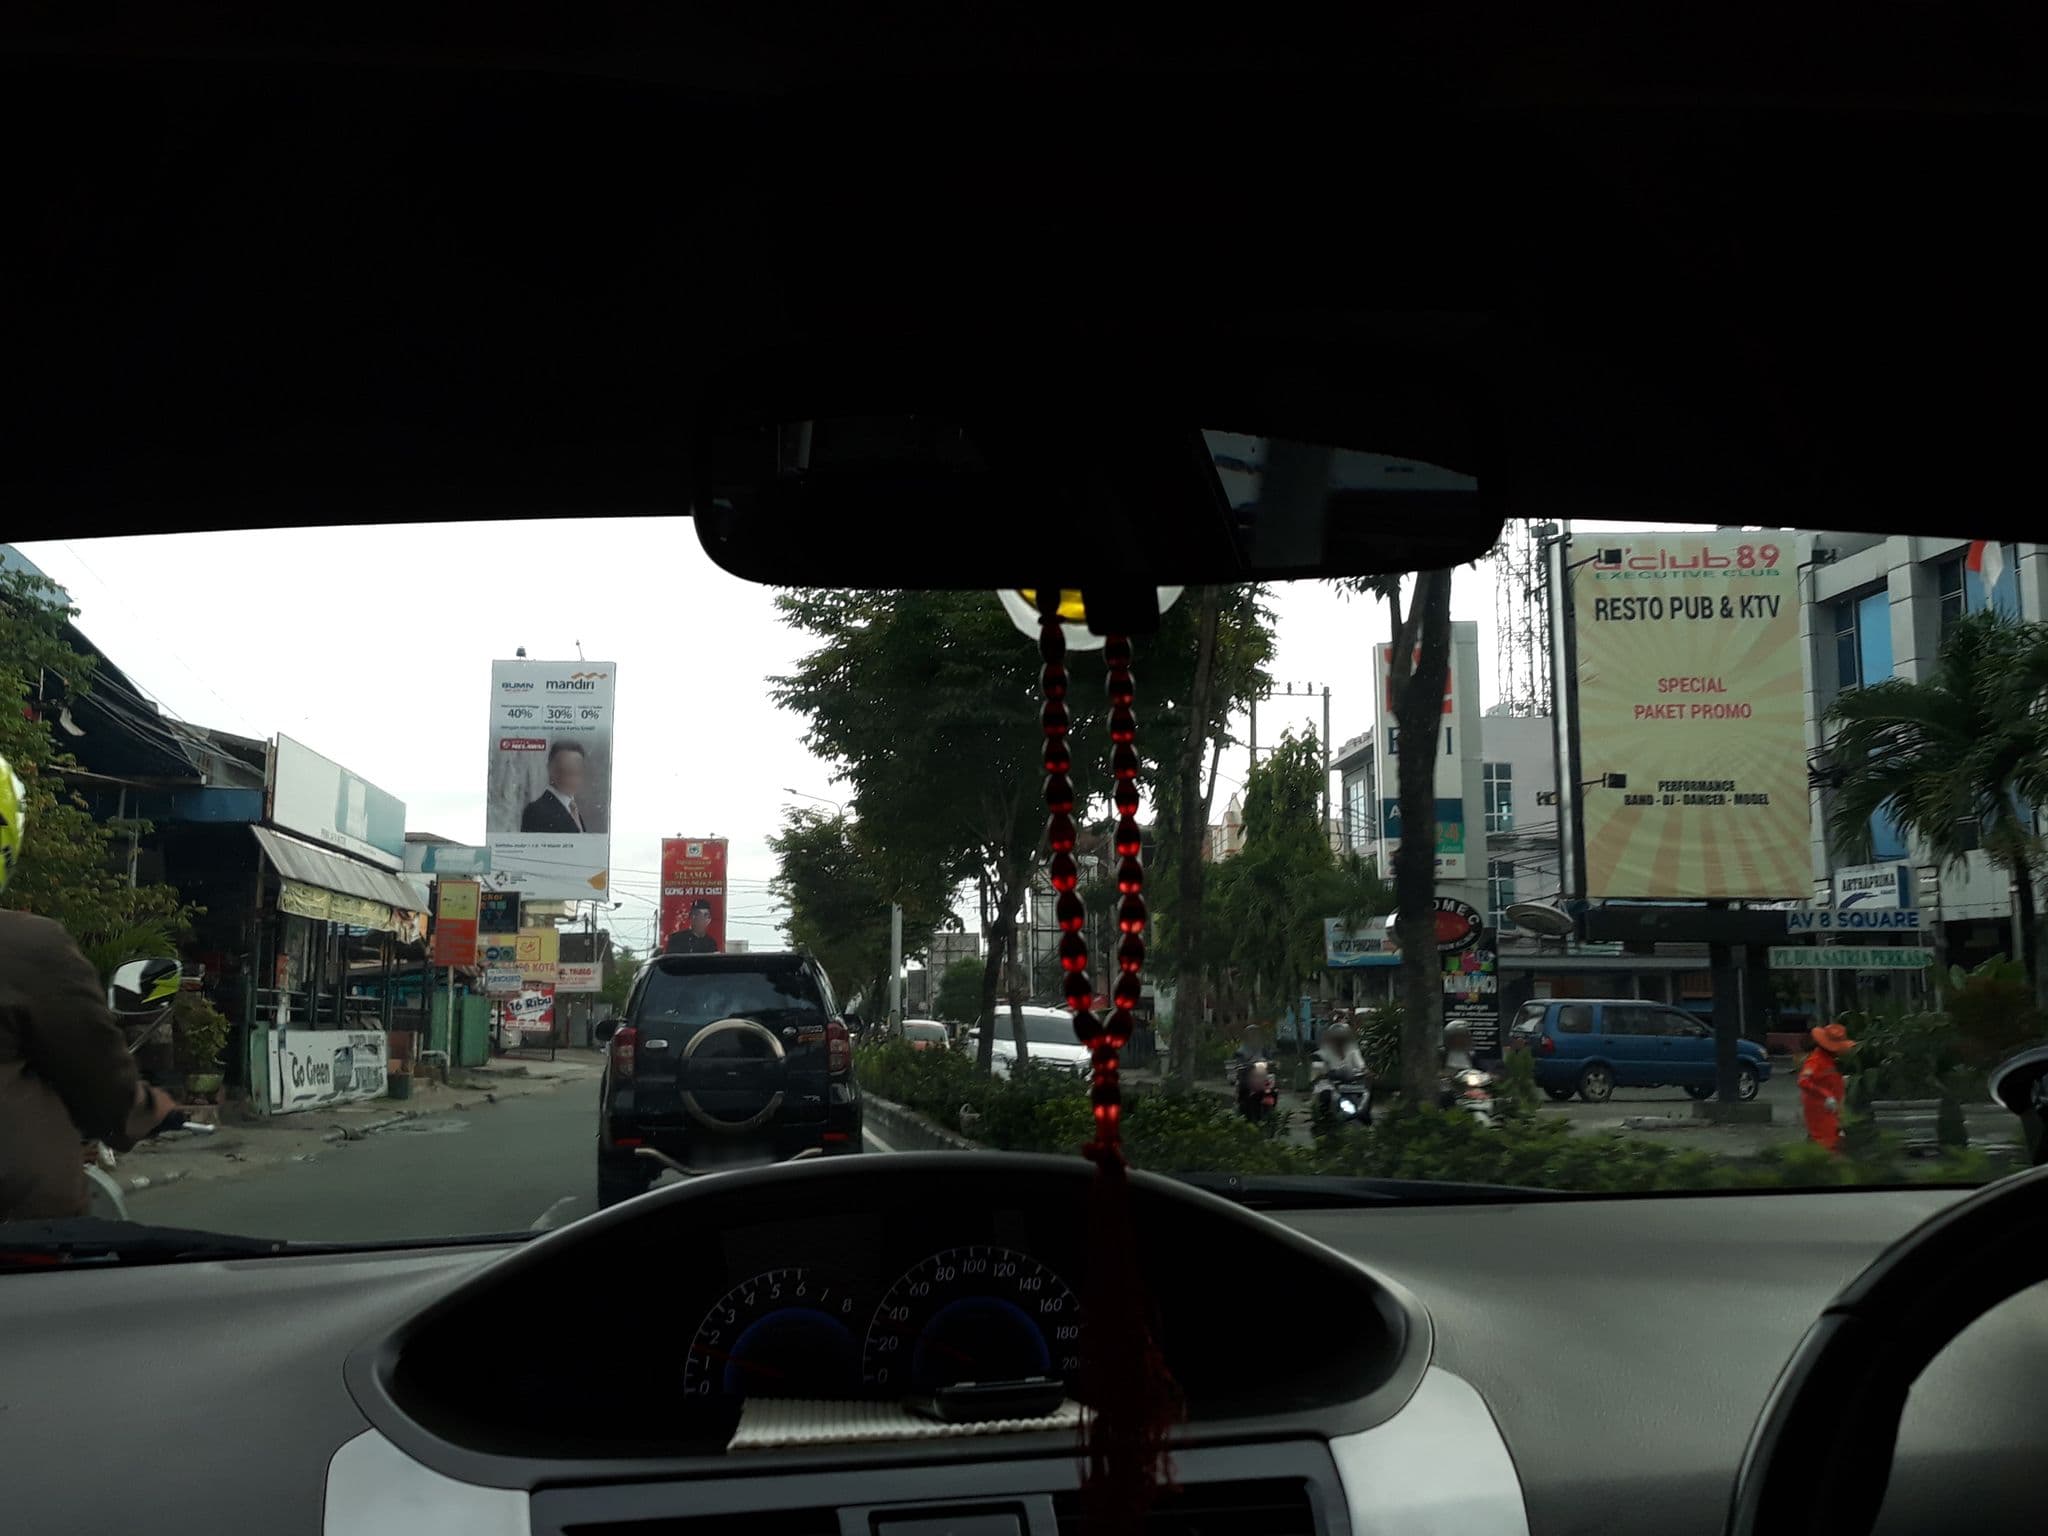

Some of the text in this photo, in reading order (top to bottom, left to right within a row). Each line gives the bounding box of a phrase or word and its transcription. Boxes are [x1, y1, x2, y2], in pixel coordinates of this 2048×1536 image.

[1736, 544, 1780, 568] 89
[1595, 568, 1780, 580] EXECUTIVE CLUB
[1595, 595, 1780, 621] RESTO PUB & KTV
[545, 678, 595, 690] mandiri
[1658, 677, 1727, 693] SPECIAL
[507, 708, 533, 719] 40%
[547, 709, 573, 719] 30%
[581, 709, 600, 720] 0%
[1634, 703, 1752, 720] PAKET PROMO
[1658, 780, 1735, 791] PERFORMANCE
[1624, 795, 1654, 805] BAND
[1683, 794, 1726, 805] DANCER
[1734, 793, 1769, 805] MODEL
[1820, 913, 1830, 928] 8
[1837, 912, 1920, 928] SQUARE
[509, 996, 552, 1011] 16 Ribu
[306, 1055, 330, 1086] Green
[962, 1258, 987, 1273] 100
[993, 1262, 1016, 1277] 120
[935, 1266, 956, 1281] 80
[770, 1283, 782, 1299] 5
[796, 1281, 806, 1296] 6
[909, 1281, 930, 1297] 60
[1019, 1276, 1042, 1291] 140
[744, 1291, 755, 1307] 4
[820, 1288, 830, 1302] 7
[842, 1298, 852, 1312] 8
[1040, 1298, 1063, 1312] 160
[725, 1308, 736, 1324] 3
[889, 1306, 910, 1321] 40
[710, 1330, 720, 1345] 2
[1056, 1326, 1079, 1340] 180
[879, 1336, 899, 1352] 20
[705, 1355, 711, 1371] 1
[1062, 1357, 1082, 1370] 20
[878, 1368, 888, 1384] 0
[700, 1380, 710, 1394] 0
